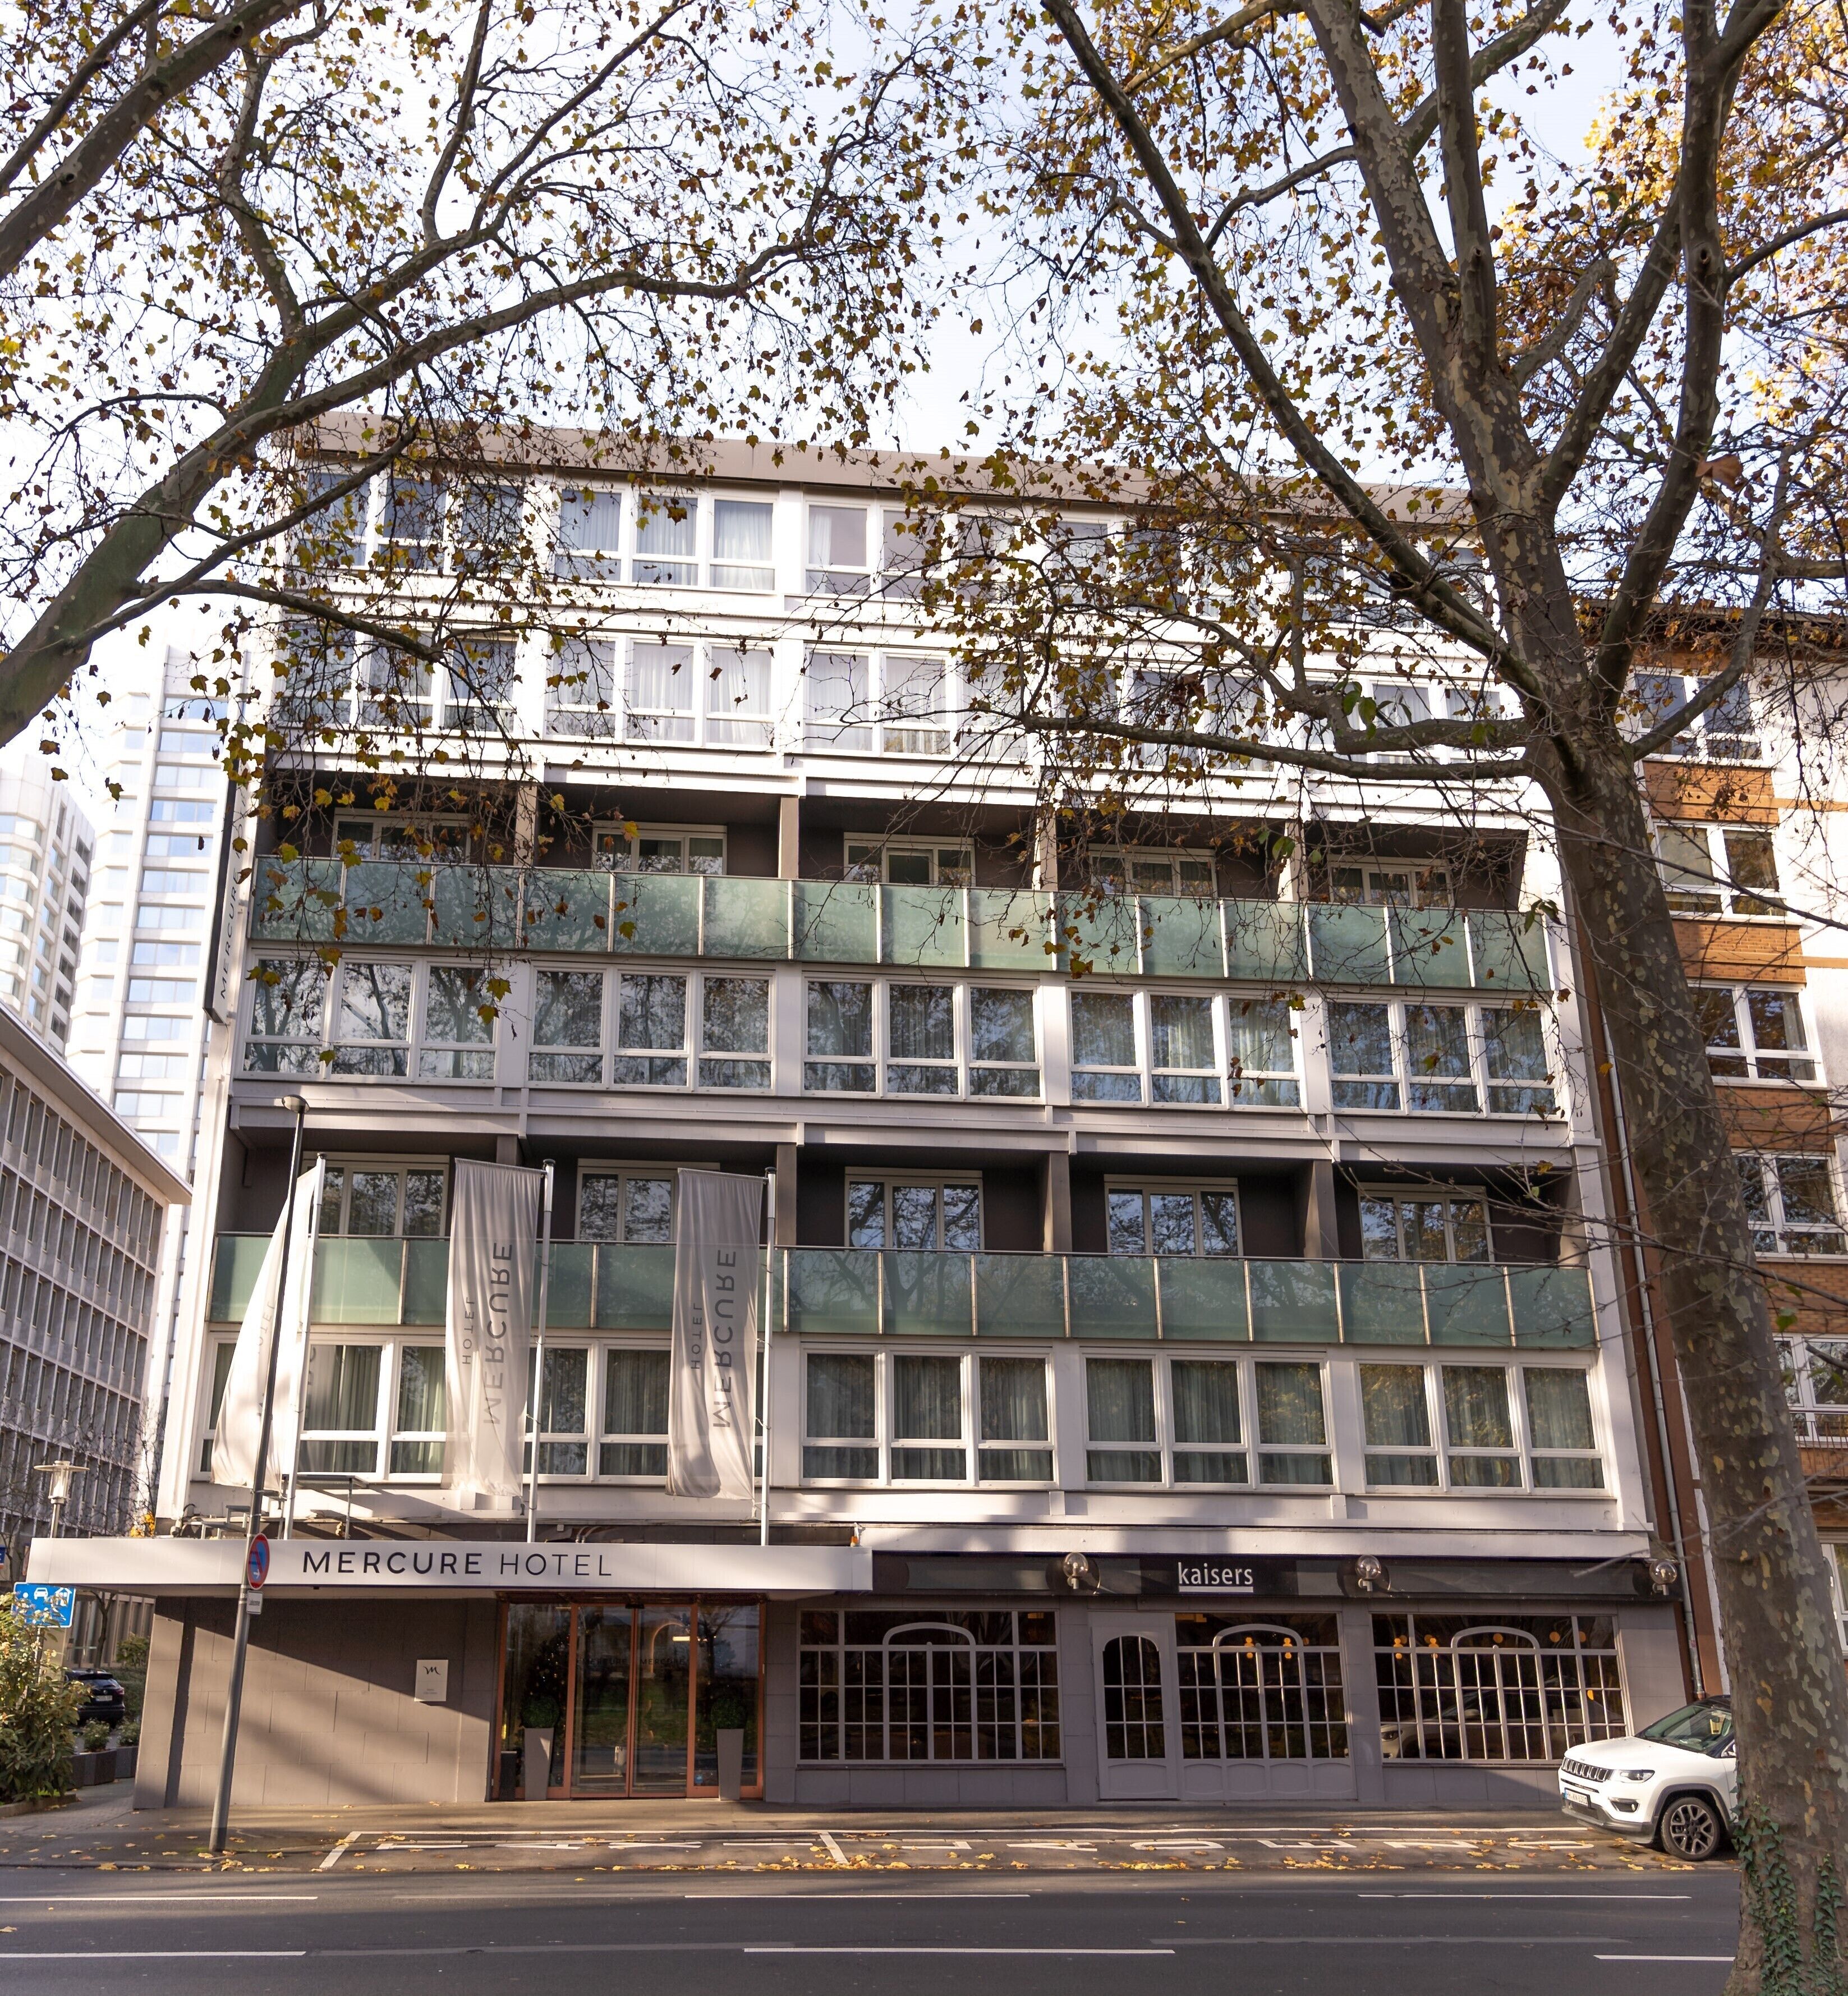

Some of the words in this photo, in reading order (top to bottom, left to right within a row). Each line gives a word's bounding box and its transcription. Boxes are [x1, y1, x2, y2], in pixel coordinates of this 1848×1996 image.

[220, 868, 241, 999] MERCURE
[303, 1551, 482, 1574] MERCURE
[500, 1553, 612, 1576] HOTEL
[1178, 1562, 1253, 1584] kaisers
